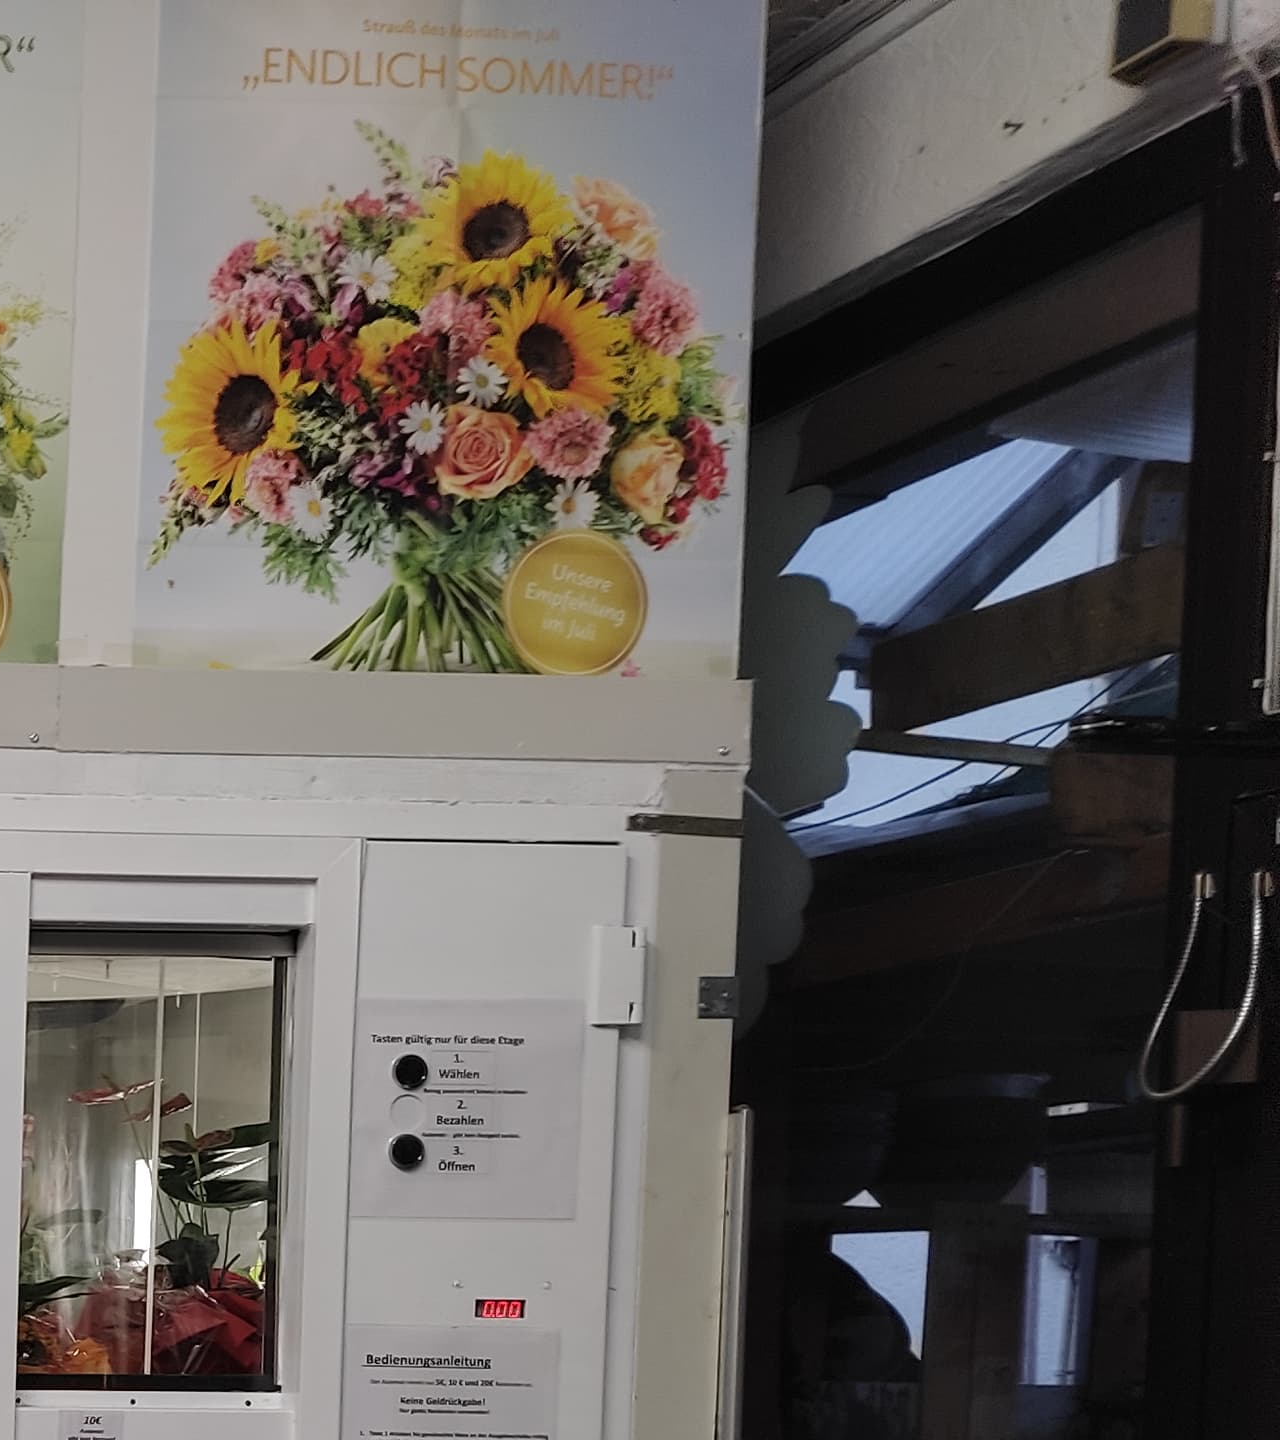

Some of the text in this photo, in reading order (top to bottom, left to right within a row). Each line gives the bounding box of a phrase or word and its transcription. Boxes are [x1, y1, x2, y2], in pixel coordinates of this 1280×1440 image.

[242, 47, 675, 101] „ENDLICH SOMMER!“
[552, 563, 614, 593] Unsere
[525, 582, 625, 628] Empfehlung
[566, 619, 597, 641] Juli
[371, 1034, 525, 1046] Tasten gültig nur für diese Etage
[454, 1054, 464, 1064] 1.
[439, 1069, 480, 1080] Wählen
[456, 1100, 467, 1110] 2.
[436, 1115, 484, 1126] Bezahlen
[453, 1146, 464, 1156] 3.
[438, 1160, 475, 1172] Öffnen
[366, 1354, 492, 1369] Bedienungsanleitung
[400, 1397, 486, 1407] Keine Geldrückgabe!
[83, 1416, 103, 1425] 10€
